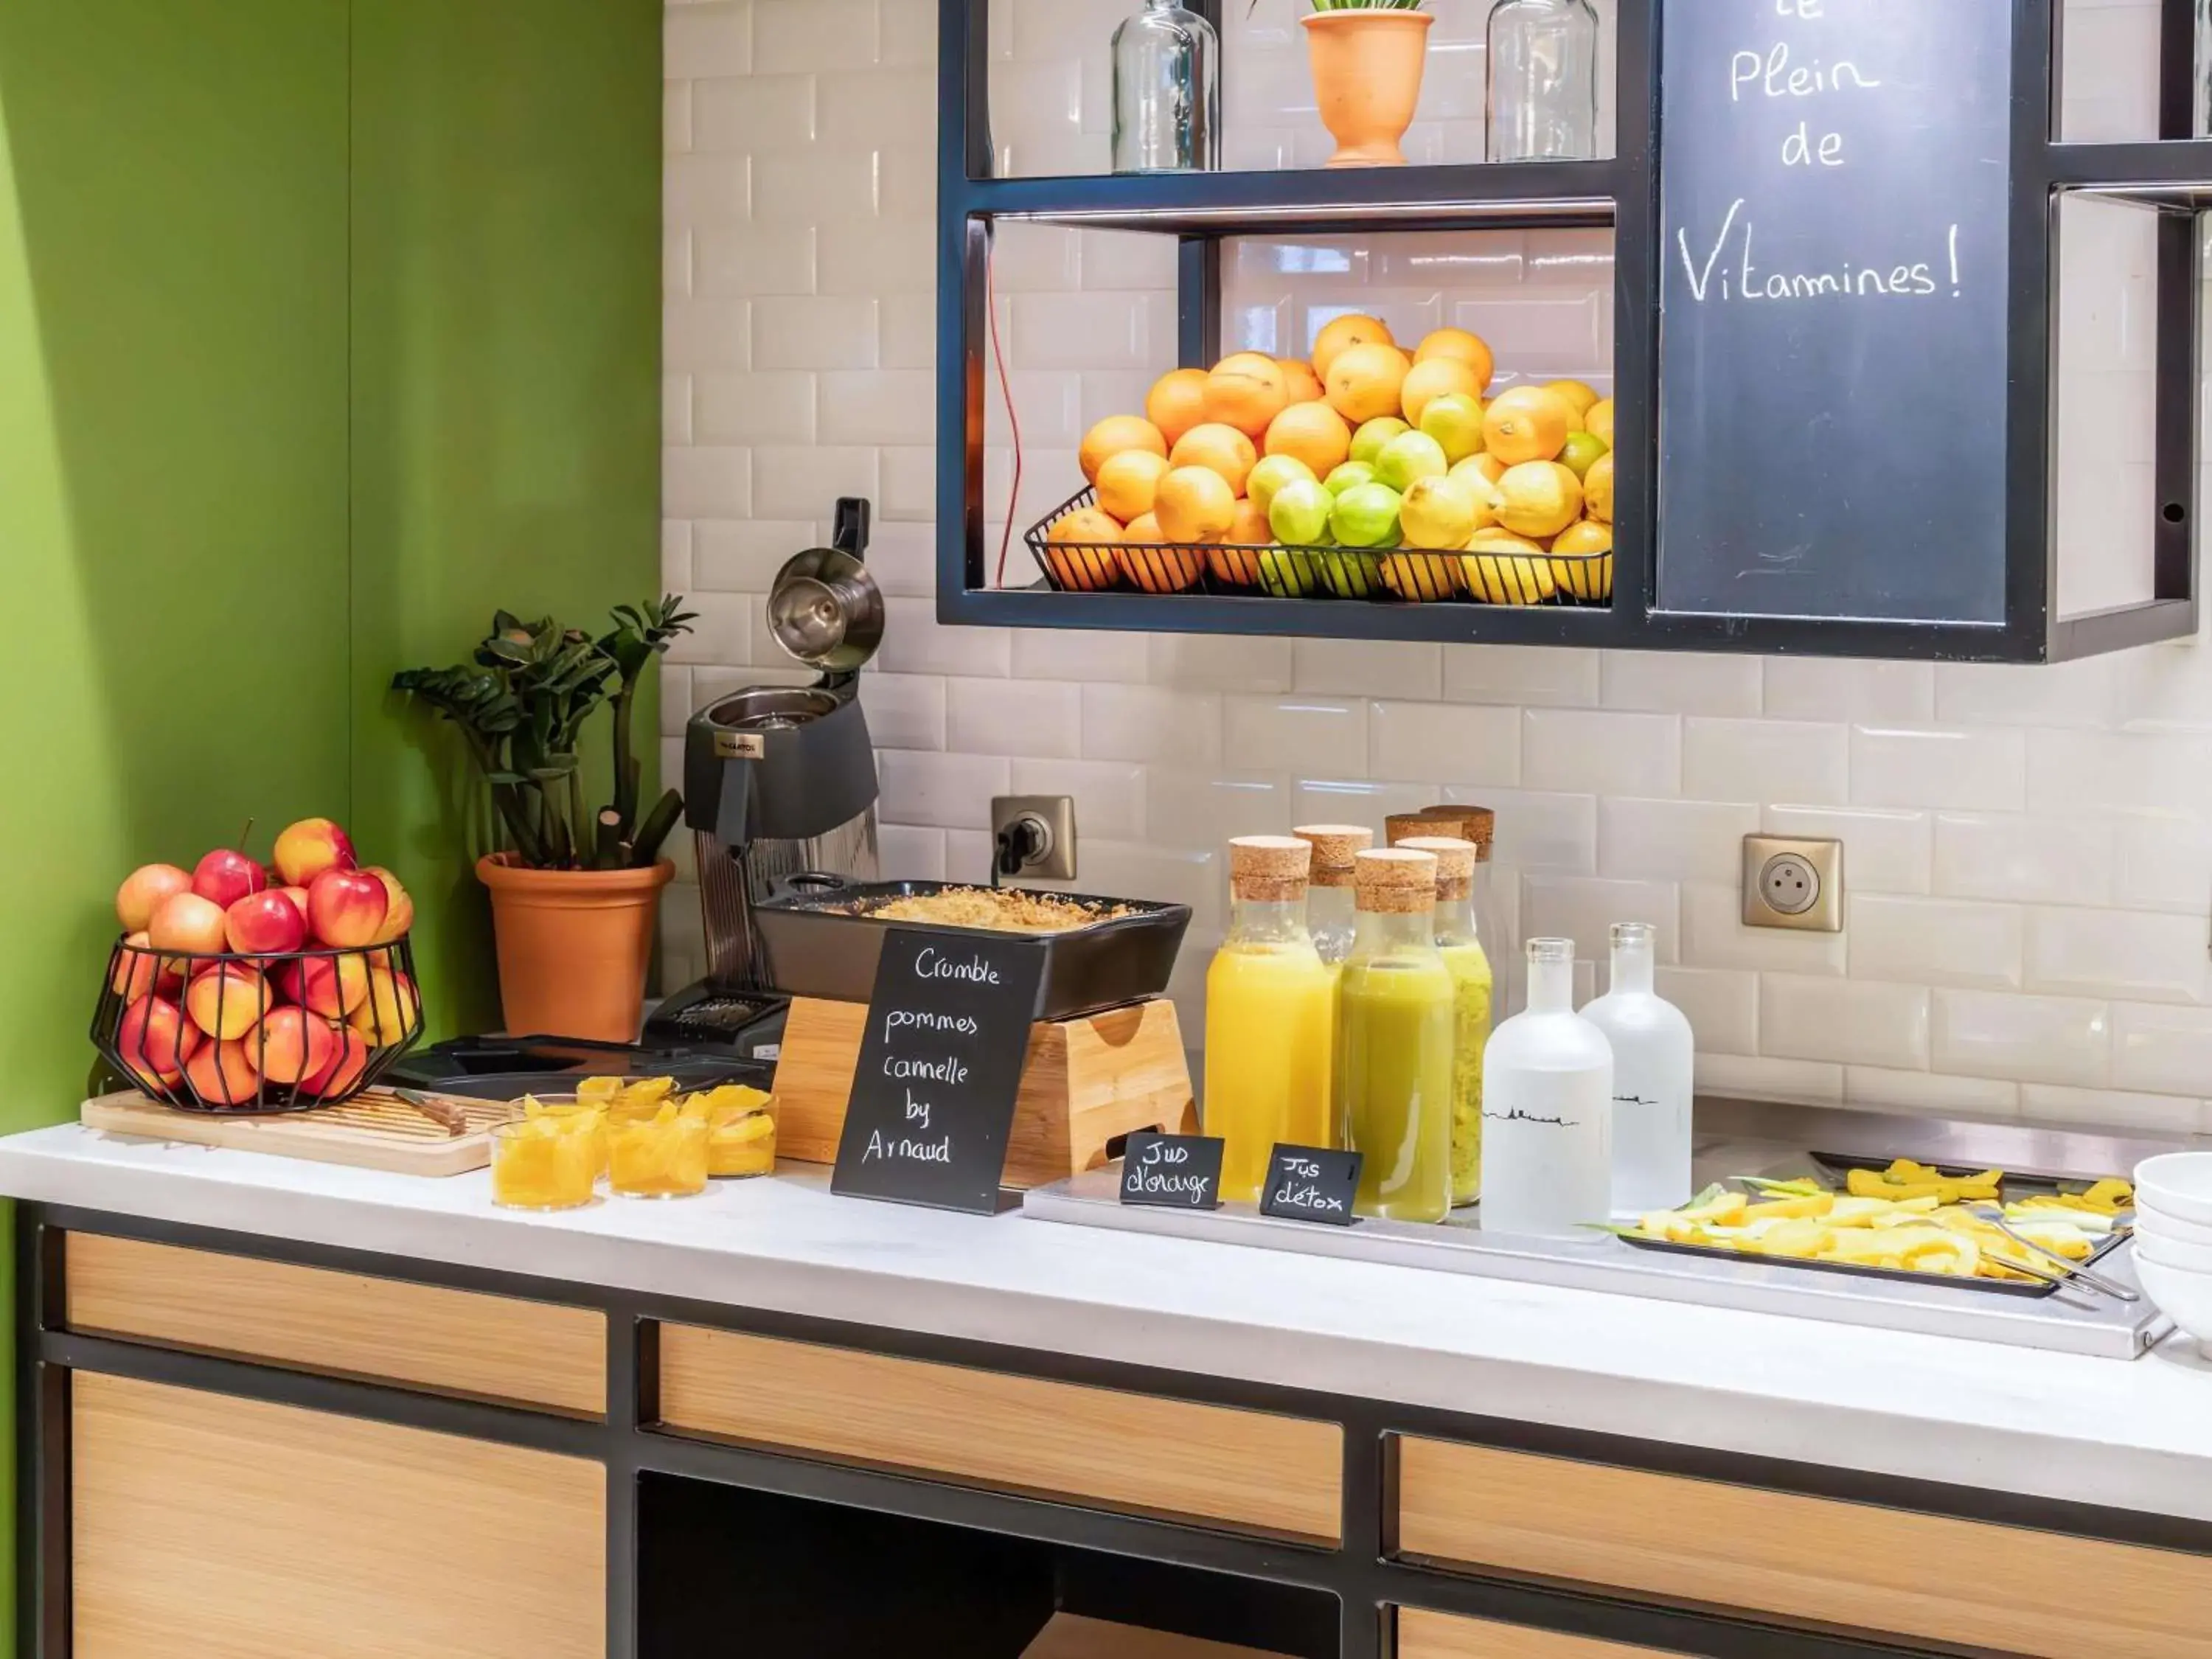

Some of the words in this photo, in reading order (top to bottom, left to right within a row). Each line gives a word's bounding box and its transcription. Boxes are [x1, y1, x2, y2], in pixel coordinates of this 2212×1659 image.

[1731, 42, 1880, 101] Plein
[1781, 122, 1844, 165] de
[886, 1011, 978, 1043] pommes
[906, 1088, 930, 1129] by
[862, 1130, 951, 1164] Arnaud
[1143, 1141, 1189, 1164] Jus
[1280, 1158, 1321, 1178] Jus
